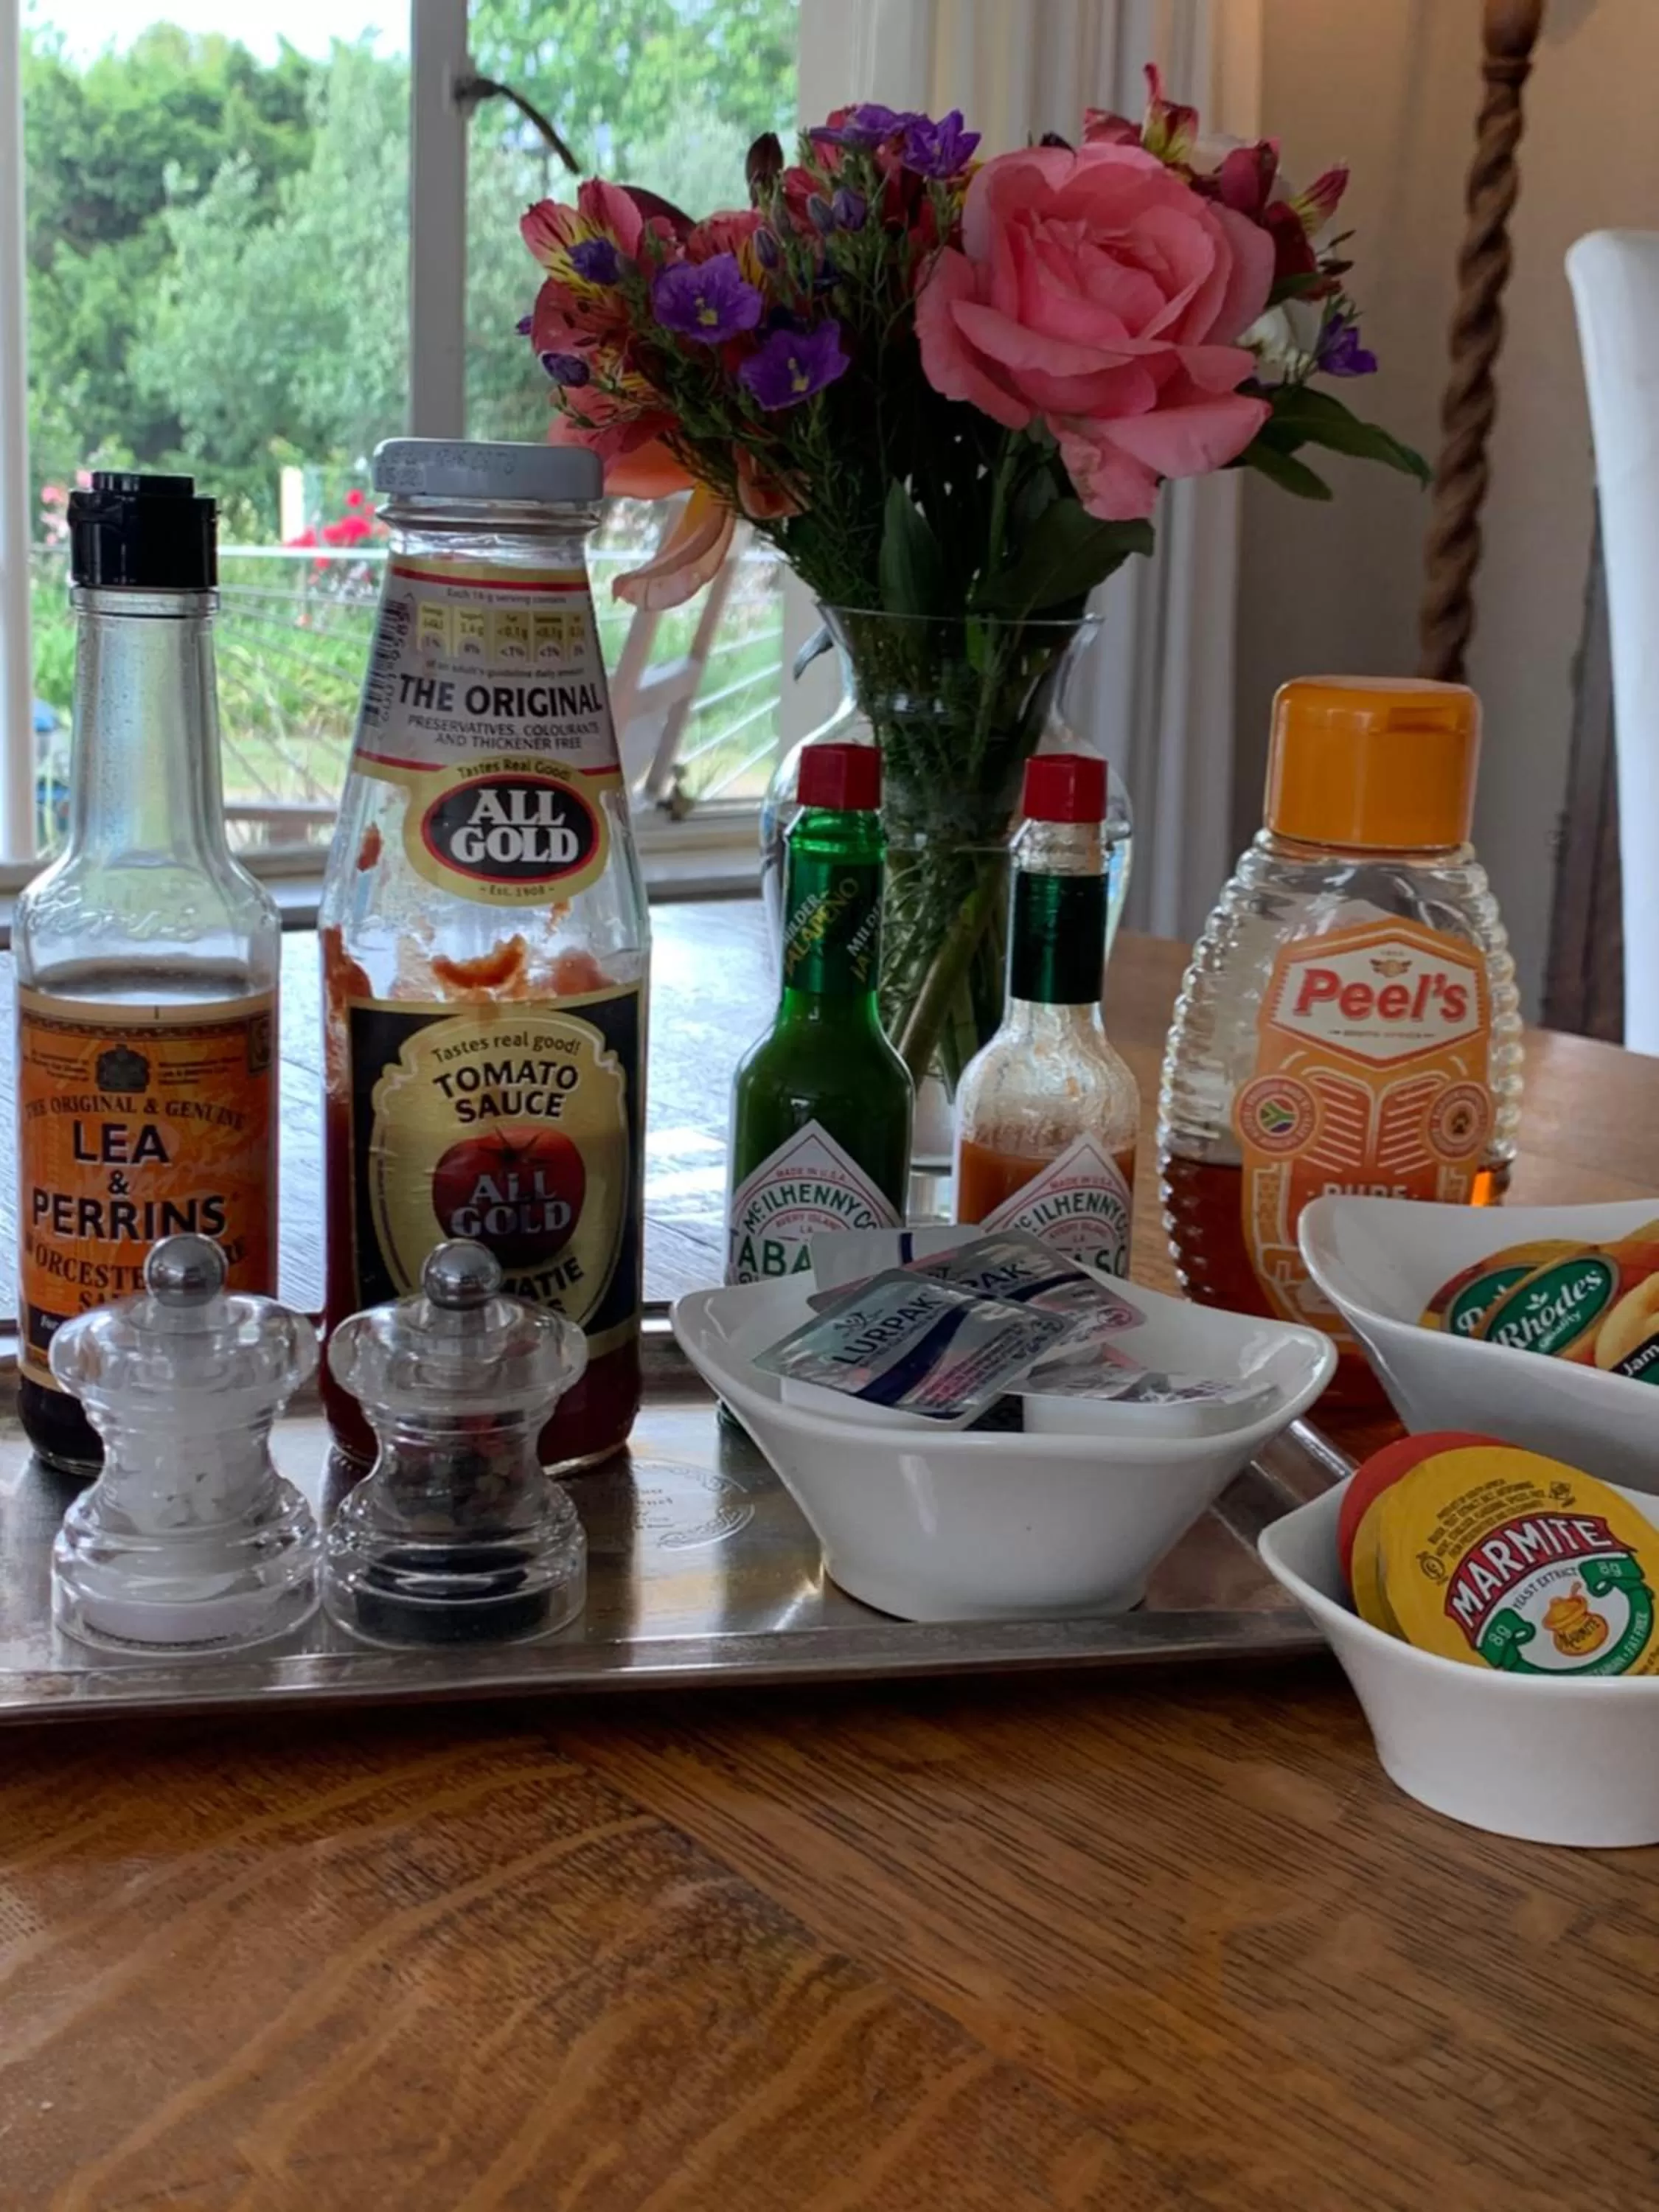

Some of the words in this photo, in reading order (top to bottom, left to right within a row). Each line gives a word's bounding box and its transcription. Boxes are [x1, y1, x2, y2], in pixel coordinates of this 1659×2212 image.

[399, 673, 456, 712] THE
[465, 683, 603, 718] ORIGINAL
[435, 733, 467, 747] AND
[472, 735, 552, 751] THICKENER
[554, 736, 582, 750] FREE
[457, 761, 501, 779] Tastes
[503, 757, 530, 771] Real
[467, 788, 566, 827] ALL
[449, 825, 580, 865] GOLD
[1293, 967, 1469, 1023] Peel's
[431, 1037, 490, 1064] Tastes
[493, 1031, 529, 1048] real
[532, 1034, 582, 1055] good!
[432, 1059, 580, 1100] TOMATO
[49, 1093, 137, 1118] ORIGINAL
[143, 1098, 159, 1114] &
[164, 1101, 247, 1133] GENUINE
[453, 1090, 566, 1124] SAUCE
[73, 1119, 170, 1164] LEA
[107, 1169, 130, 1195] &
[469, 1170, 557, 1204] ALL
[32, 1187, 226, 1242] PERRINS
[450, 1200, 572, 1237] GOLD
[1492, 1268, 1605, 1350] Rhodes
[832, 1293, 945, 1366] LURPAK
[1622, 1344, 1659, 1377] Jam
[1451, 1516, 1613, 1627] MARMITE
[1512, 1582, 1539, 1611] YEAST
[1536, 1565, 1579, 1588] EXTRACT
[1596, 1562, 1623, 1577] 8g
[1487, 1624, 1512, 1647] 8g
